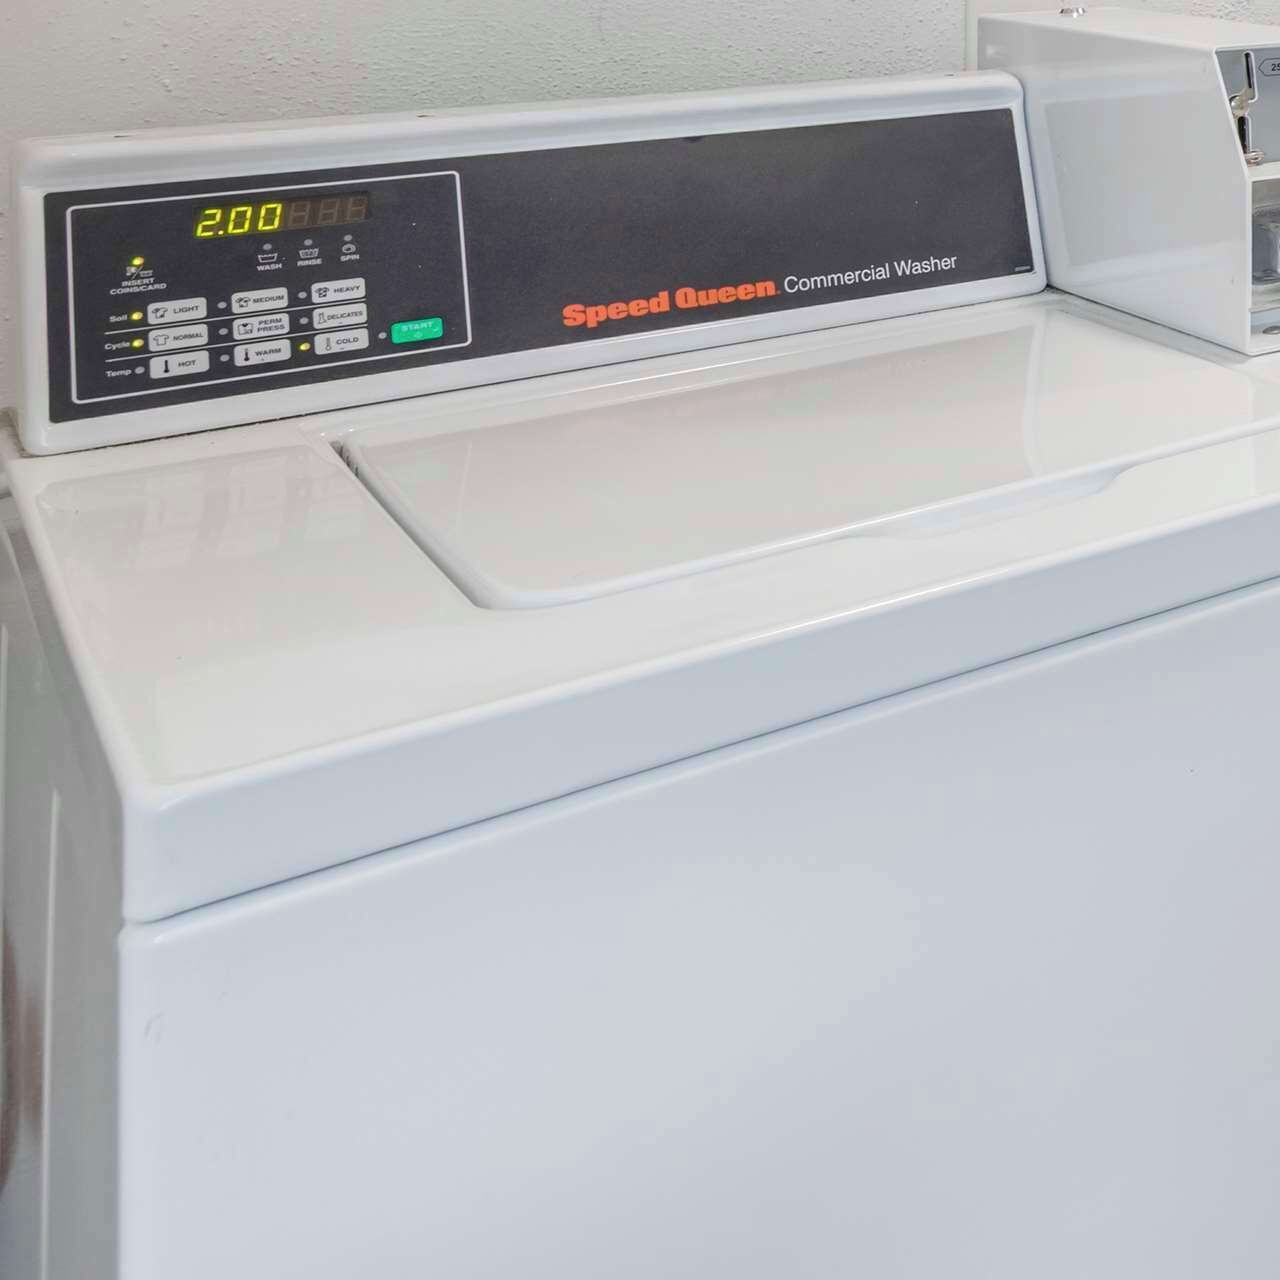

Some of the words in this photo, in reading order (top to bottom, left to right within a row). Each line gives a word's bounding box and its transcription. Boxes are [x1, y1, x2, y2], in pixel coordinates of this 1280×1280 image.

[196, 203, 283, 237] 2.00
[297, 258, 322, 266] RINSE
[256, 263, 283, 271] WASH
[121, 277, 155, 287] INSERT
[333, 285, 361, 293] HEAVY
[562, 290, 670, 328] Speed
[675, 280, 777, 310] Queen
[784, 262, 891, 294] Commercial
[894, 254, 958, 276] Washer
[252, 295, 285, 304] MEDIUM
[173, 305, 201, 314] LIGHT
[327, 310, 363, 320] DELICATES
[257, 317, 283, 325] PERM
[257, 324, 286, 333] PRESS
[172, 332, 205, 341] NORMAL
[335, 336, 359, 345] COLD
[104, 340, 131, 350] Cycle
[254, 347, 282, 357] WARM
[178, 360, 197, 368] HOT
[105, 368, 132, 378] Temp
